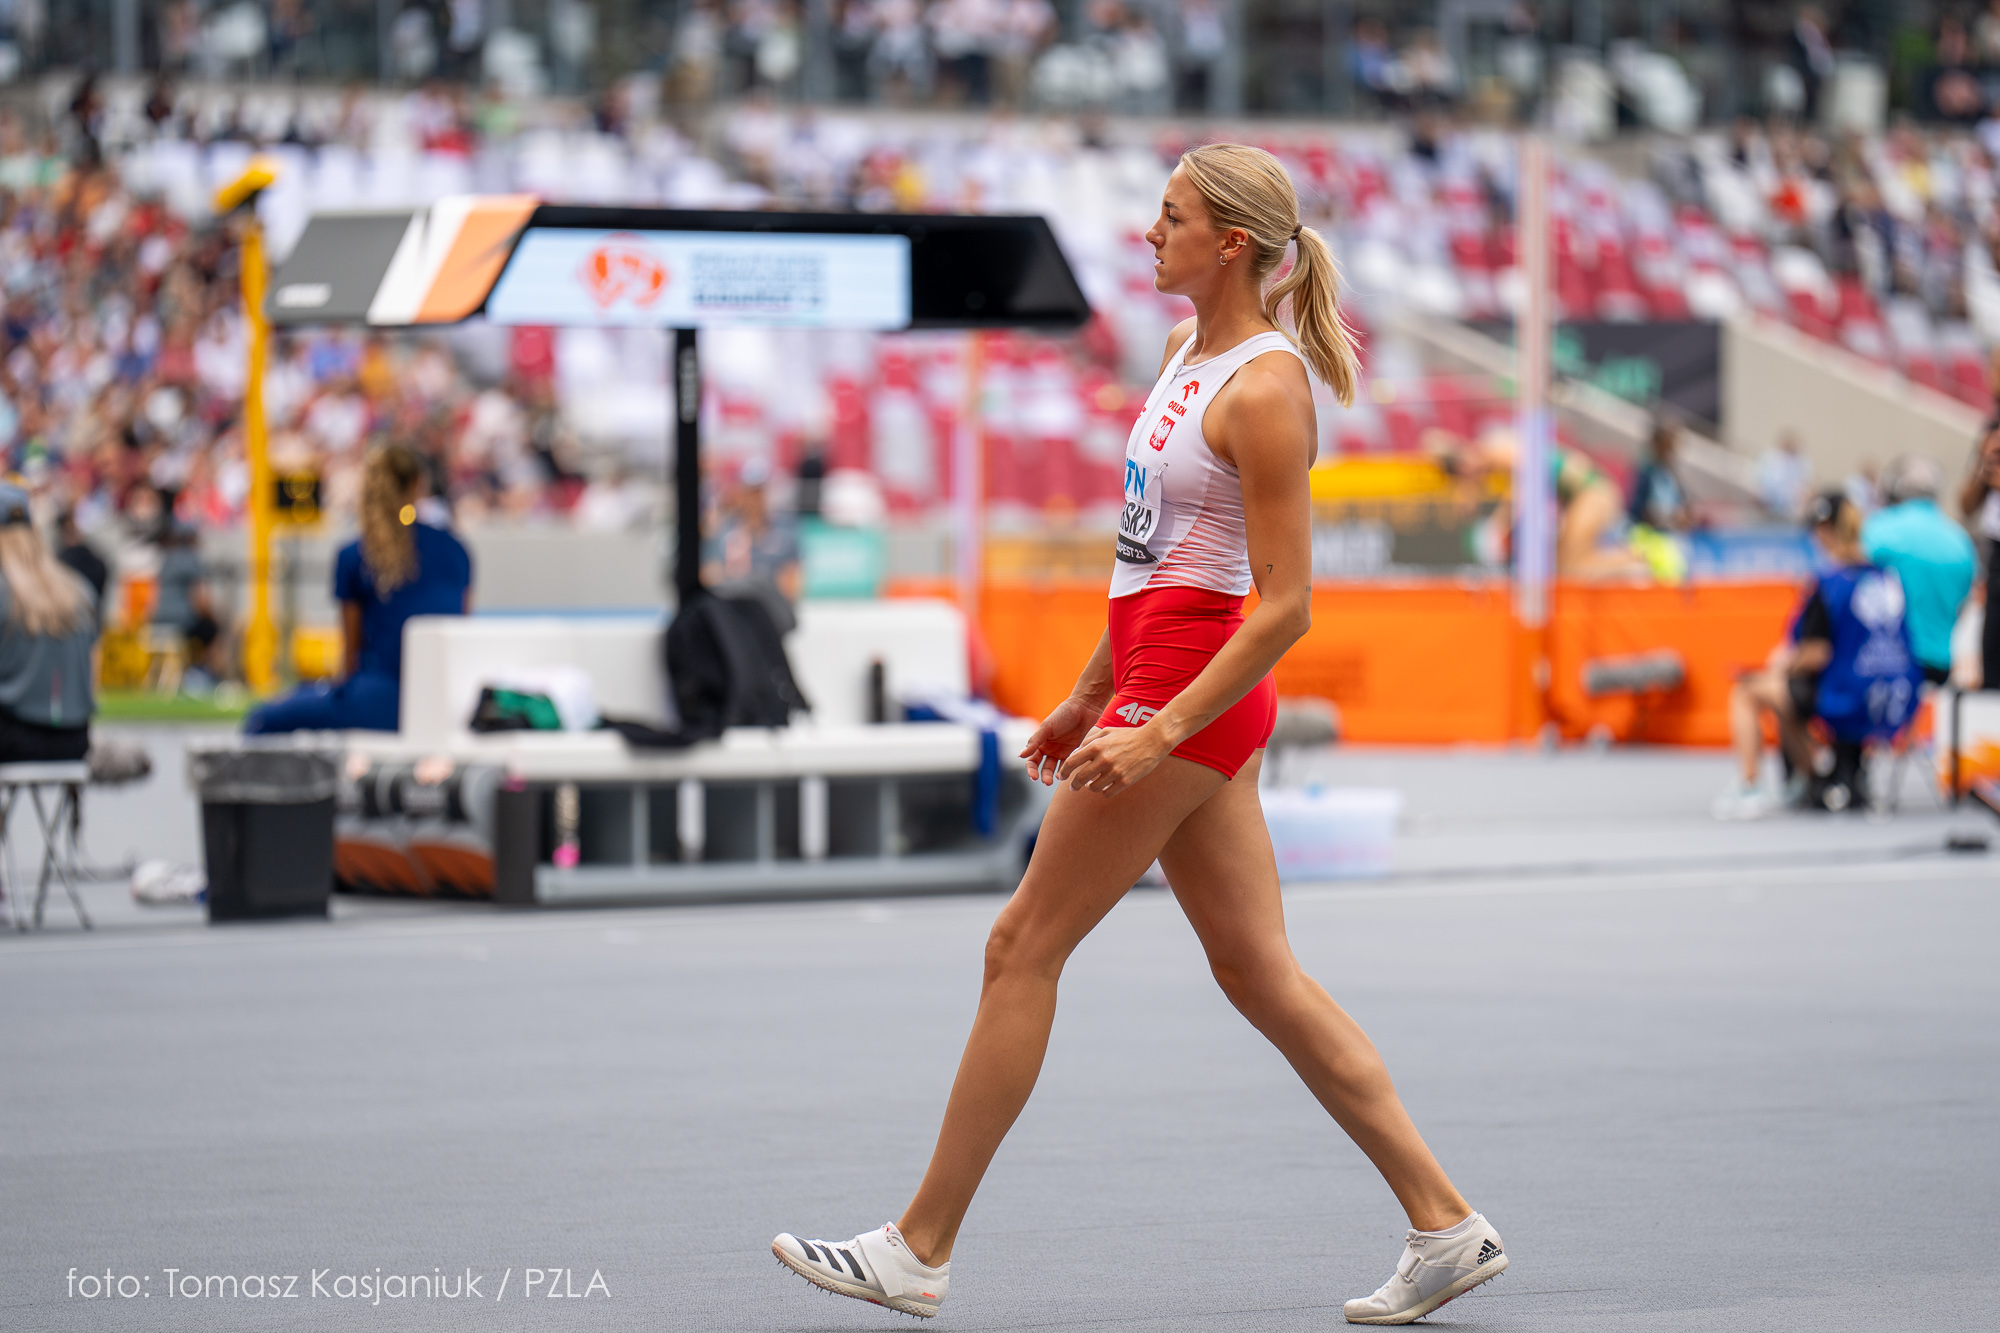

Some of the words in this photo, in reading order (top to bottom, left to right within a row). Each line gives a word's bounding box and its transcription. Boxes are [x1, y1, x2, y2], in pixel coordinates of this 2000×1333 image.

[1168, 400, 1187, 417] ORLEN
[1134, 548, 1147, 560] 23
[1116, 702, 1160, 725] 4F
[1477, 1248, 1503, 1265] adidas
